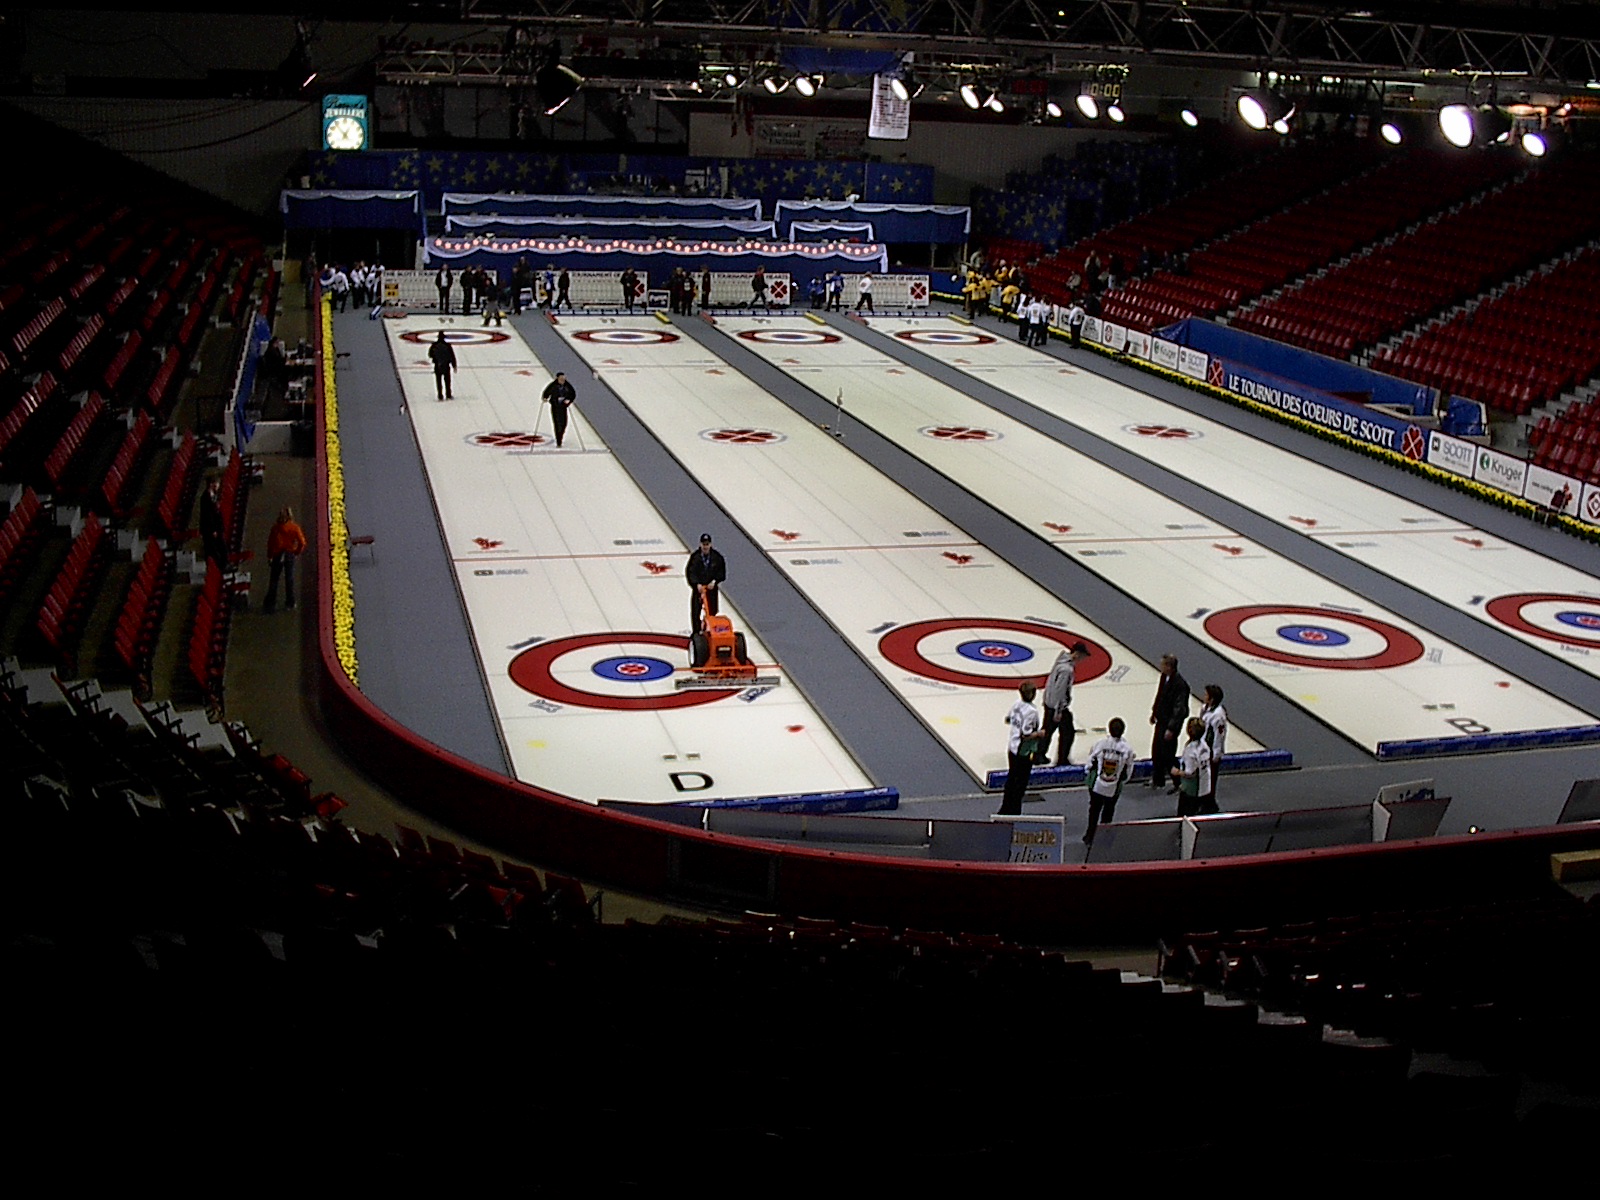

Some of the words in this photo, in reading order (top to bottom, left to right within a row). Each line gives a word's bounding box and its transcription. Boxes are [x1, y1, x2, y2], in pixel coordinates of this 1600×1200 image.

[1228, 373, 1241, 393] LE
[1240, 378, 1281, 407] TOURNOI
[1282, 392, 1301, 414] DES
[1302, 399, 1344, 429] COEURS
[1344, 413, 1359, 433] DE
[1358, 417, 1396, 448] SCOTT
[1442, 440, 1473, 463] SCOTT
[1491, 458, 1522, 481] Kruger
[1444, 718, 1491, 734] B
[669, 771, 715, 792] D
